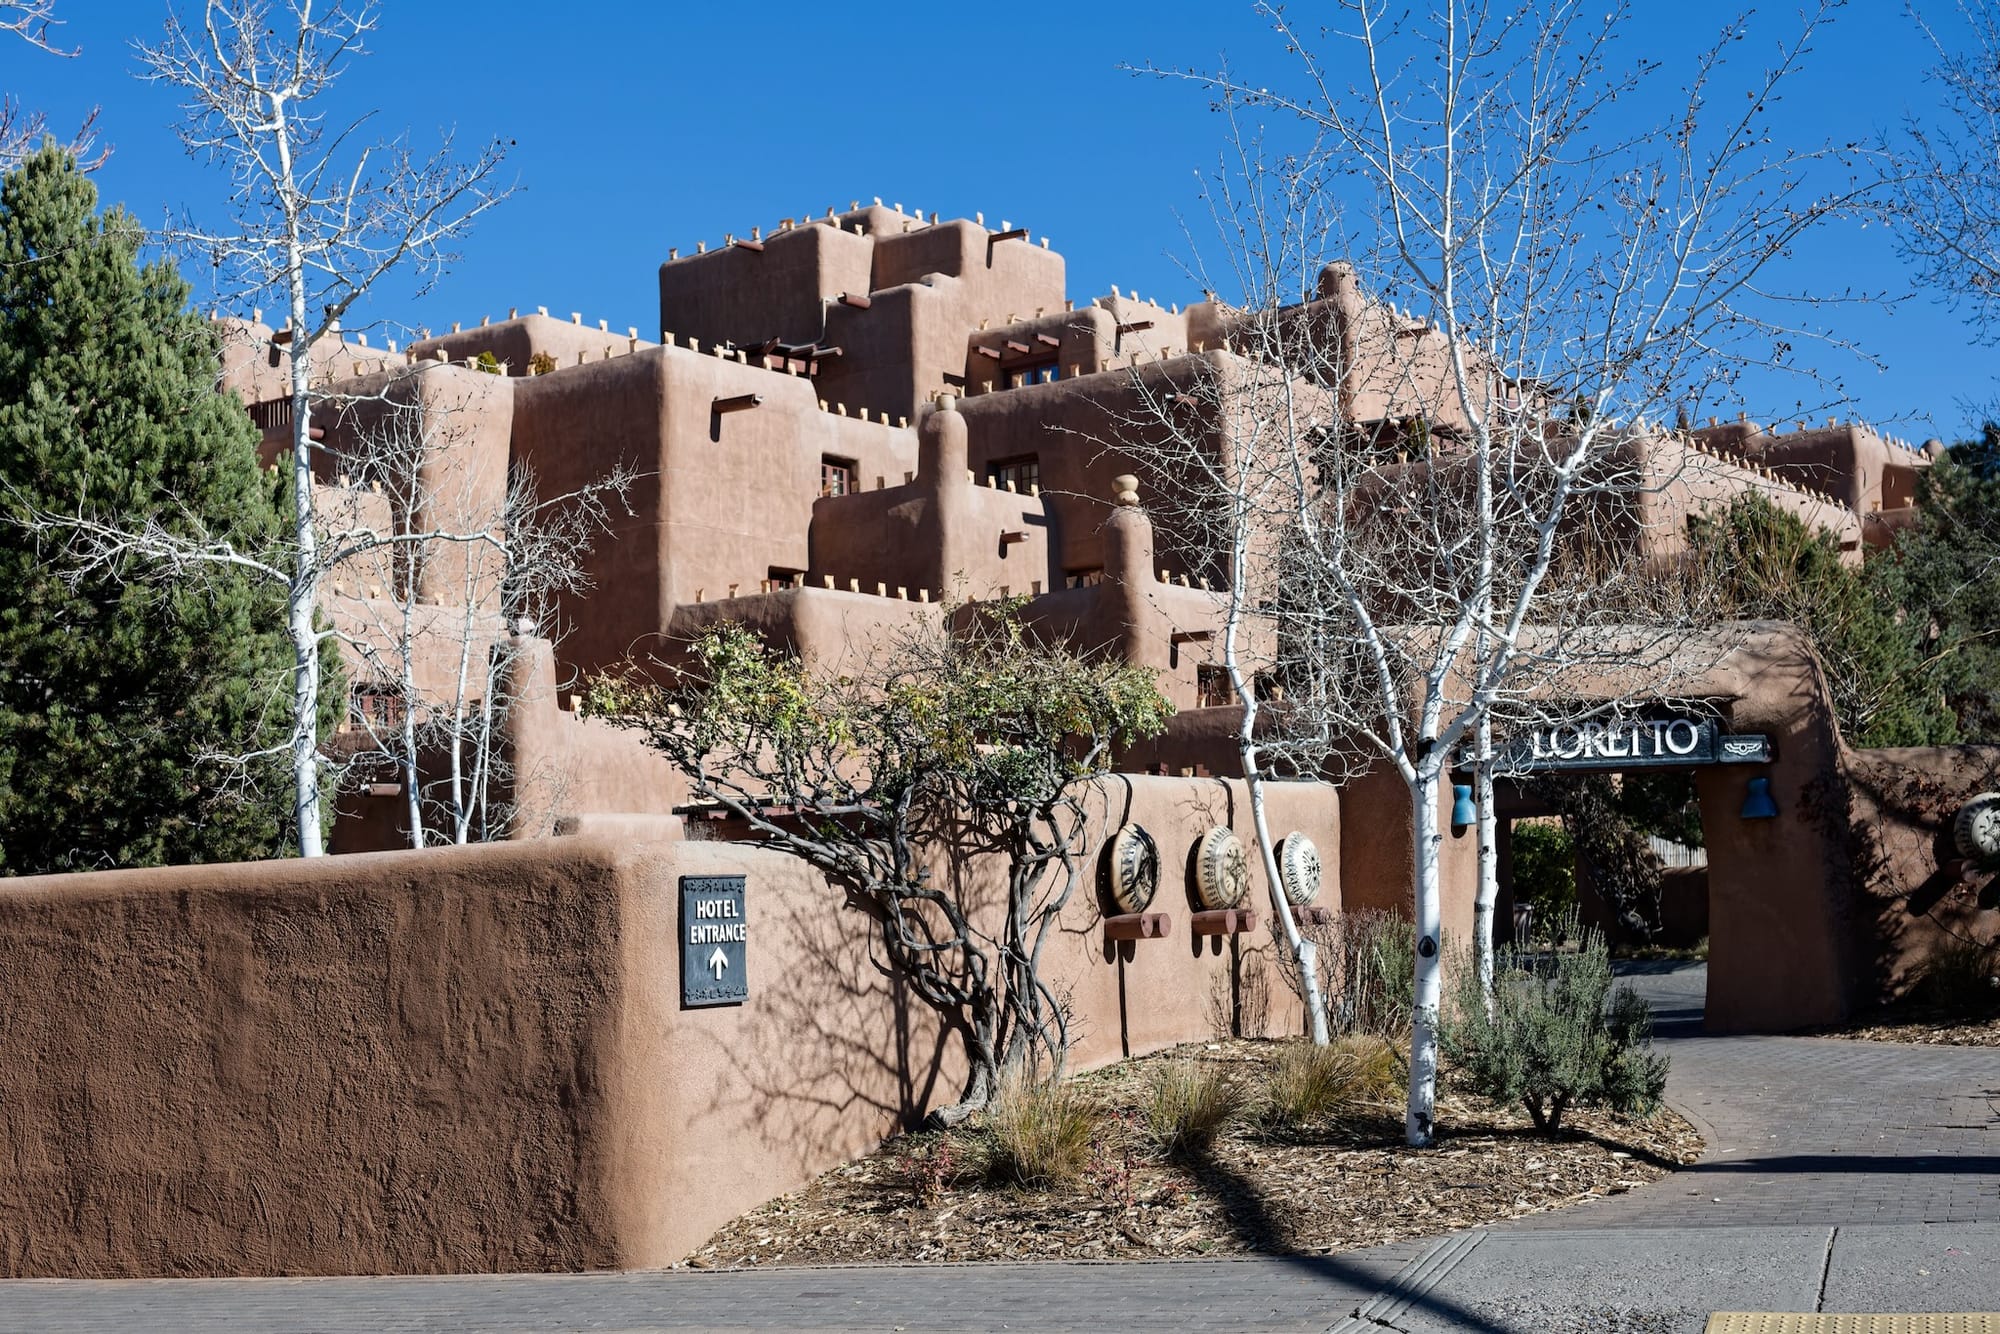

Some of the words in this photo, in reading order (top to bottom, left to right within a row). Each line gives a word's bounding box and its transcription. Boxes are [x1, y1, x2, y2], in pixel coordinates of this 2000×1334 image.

[1532, 719, 1699, 759] LORETTO
[697, 900, 739, 918] HOTEL
[690, 924, 746, 943] ENTRANCE
